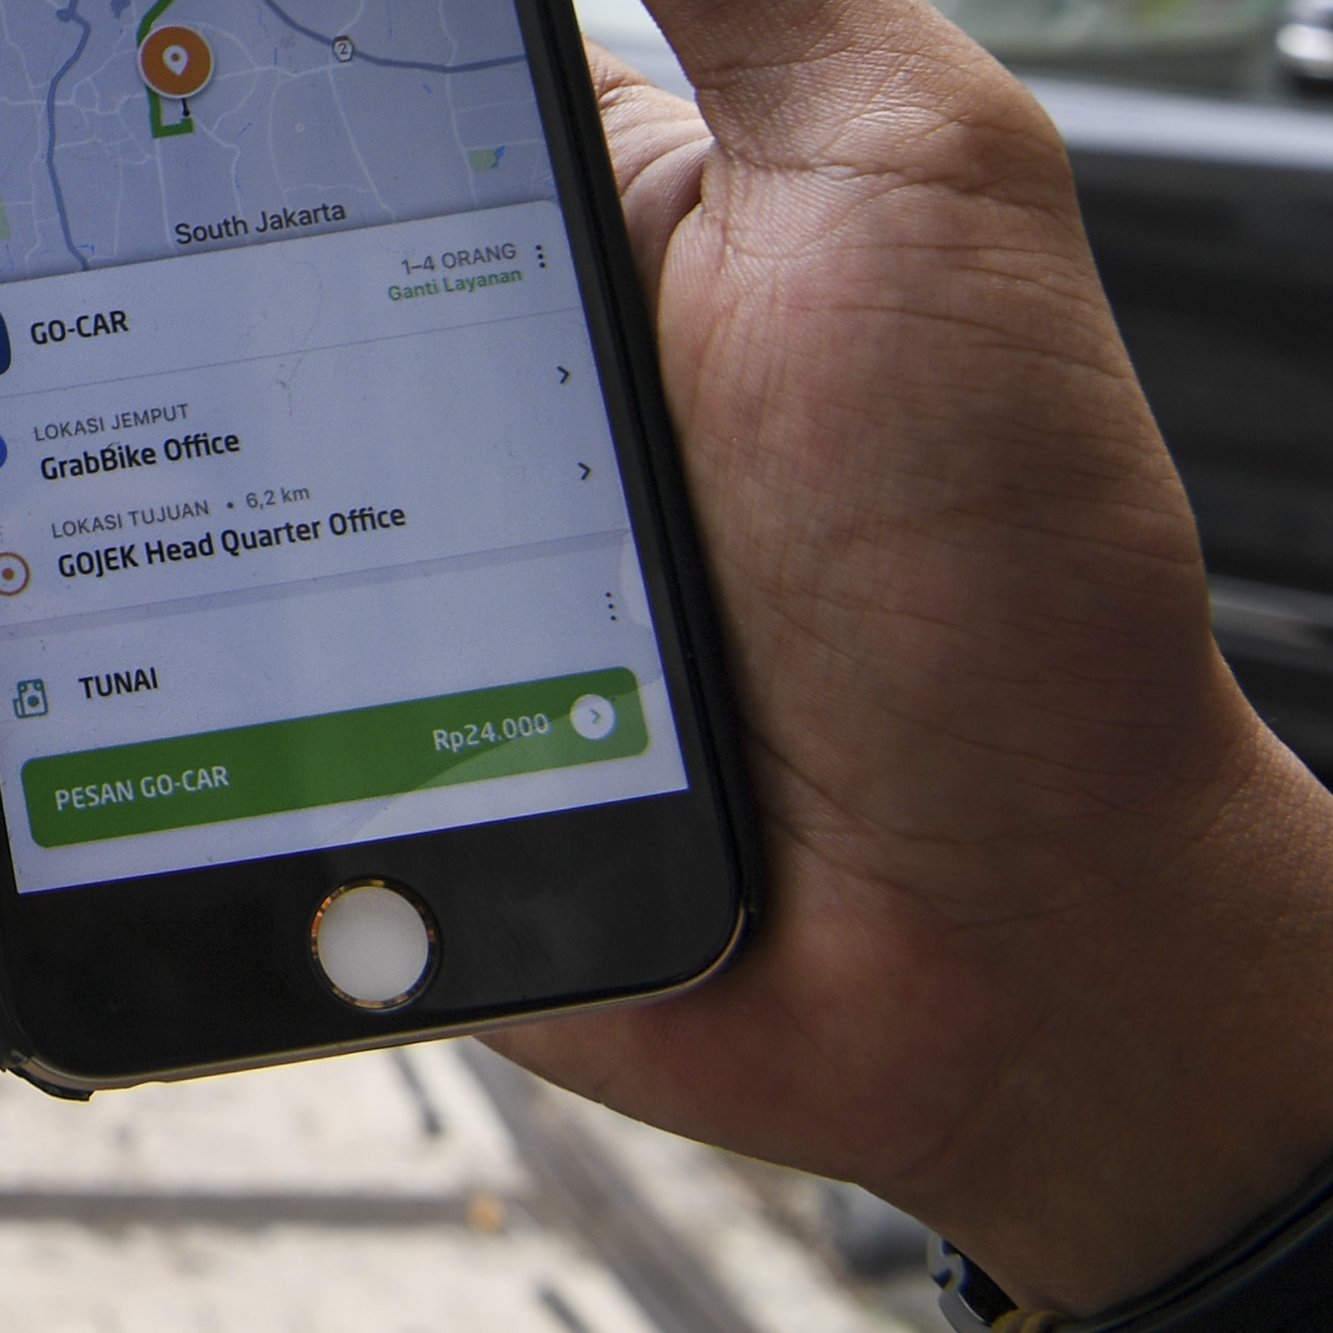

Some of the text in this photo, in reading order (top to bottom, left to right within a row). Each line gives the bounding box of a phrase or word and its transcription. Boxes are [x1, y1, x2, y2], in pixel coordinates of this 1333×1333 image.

[174, 202, 347, 245] South Jakarta
[441, 242, 518, 270] ORANG
[387, 268, 524, 302] Ganti Layanan
[30, 309, 130, 345] GO-CAR
[33, 403, 190, 442] LOKASI JEMPUT
[40, 432, 242, 481] GrabBike Office
[51, 484, 311, 540] LOKASI TUJUAN 6,2 km
[57, 506, 408, 579] GOJEK Head Quarter Office
[78, 666, 160, 700] TUNAI
[54, 712, 551, 813] PESAN GO-CAR Rp24.000
